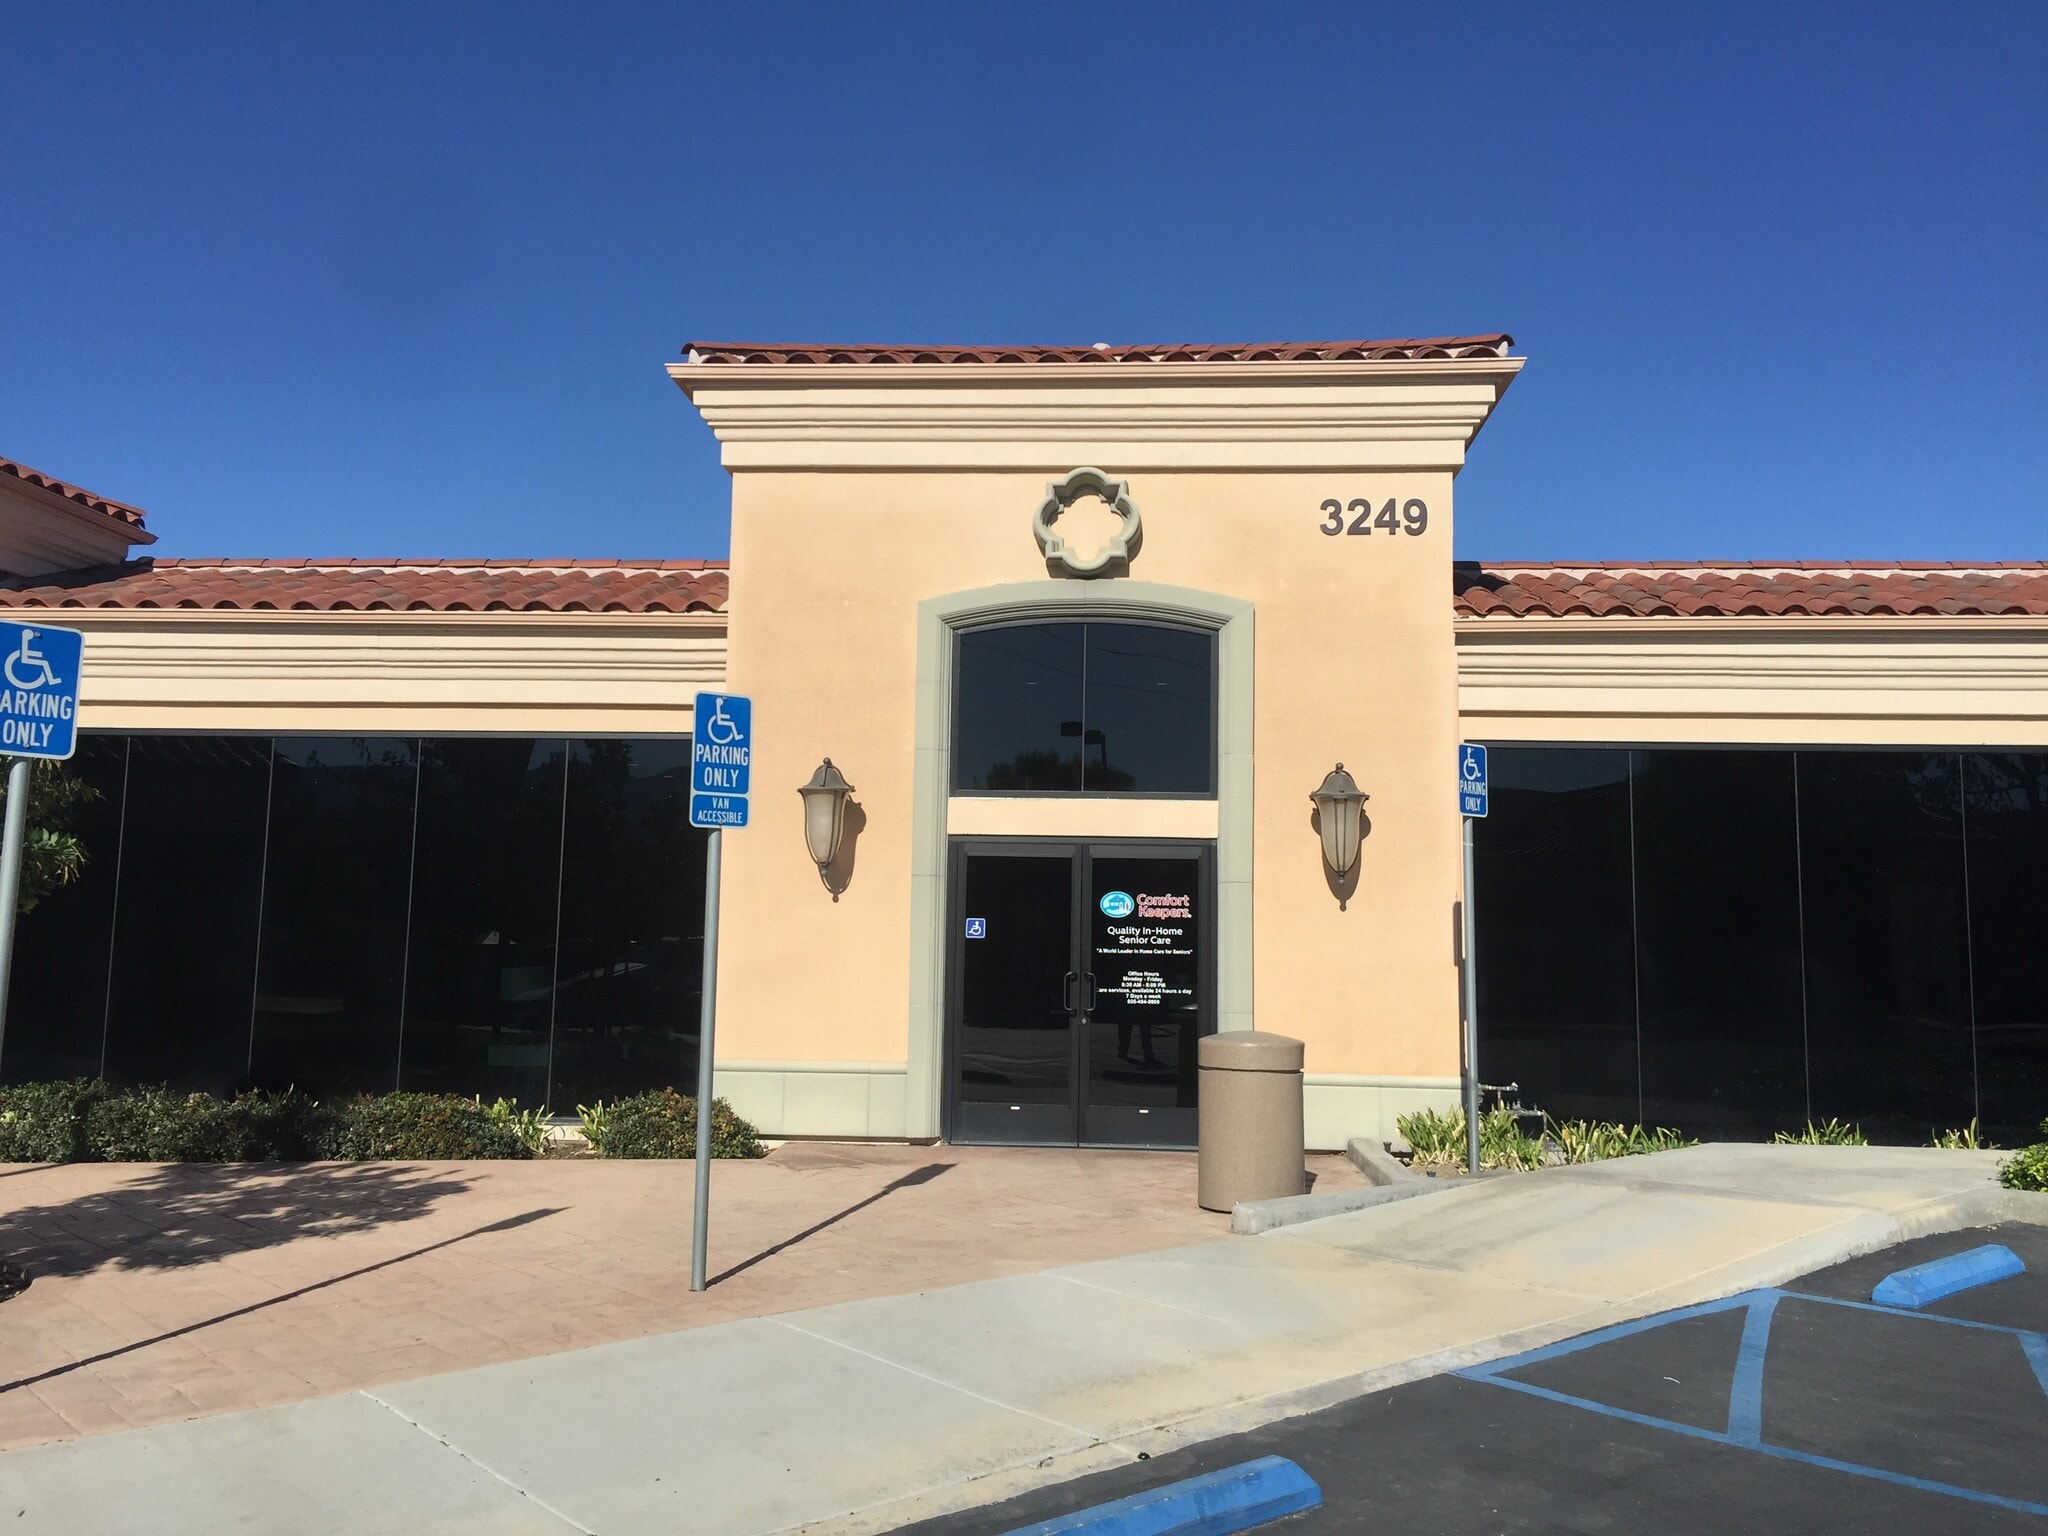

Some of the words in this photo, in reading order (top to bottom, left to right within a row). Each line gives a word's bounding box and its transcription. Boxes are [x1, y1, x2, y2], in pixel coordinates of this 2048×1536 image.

[1319, 498, 1428, 536] 3249
[0, 689, 73, 720] ARKING
[3, 719, 54, 747] ONLY
[696, 744, 749, 766] PARKING
[704, 767, 739, 788] ONLY
[1460, 780, 1486, 796] PARKING
[712, 798, 729, 809] VAN
[1465, 797, 1481, 811] ONLY
[697, 810, 743, 824] ACCESSIBLE
[1136, 893, 1190, 907] Comfort
[1107, 926, 1141, 936] Quality
[1142, 926, 1183, 935] In-Home
[1119, 936, 1149, 944] Senior
[1150, 936, 1171, 945] Care
